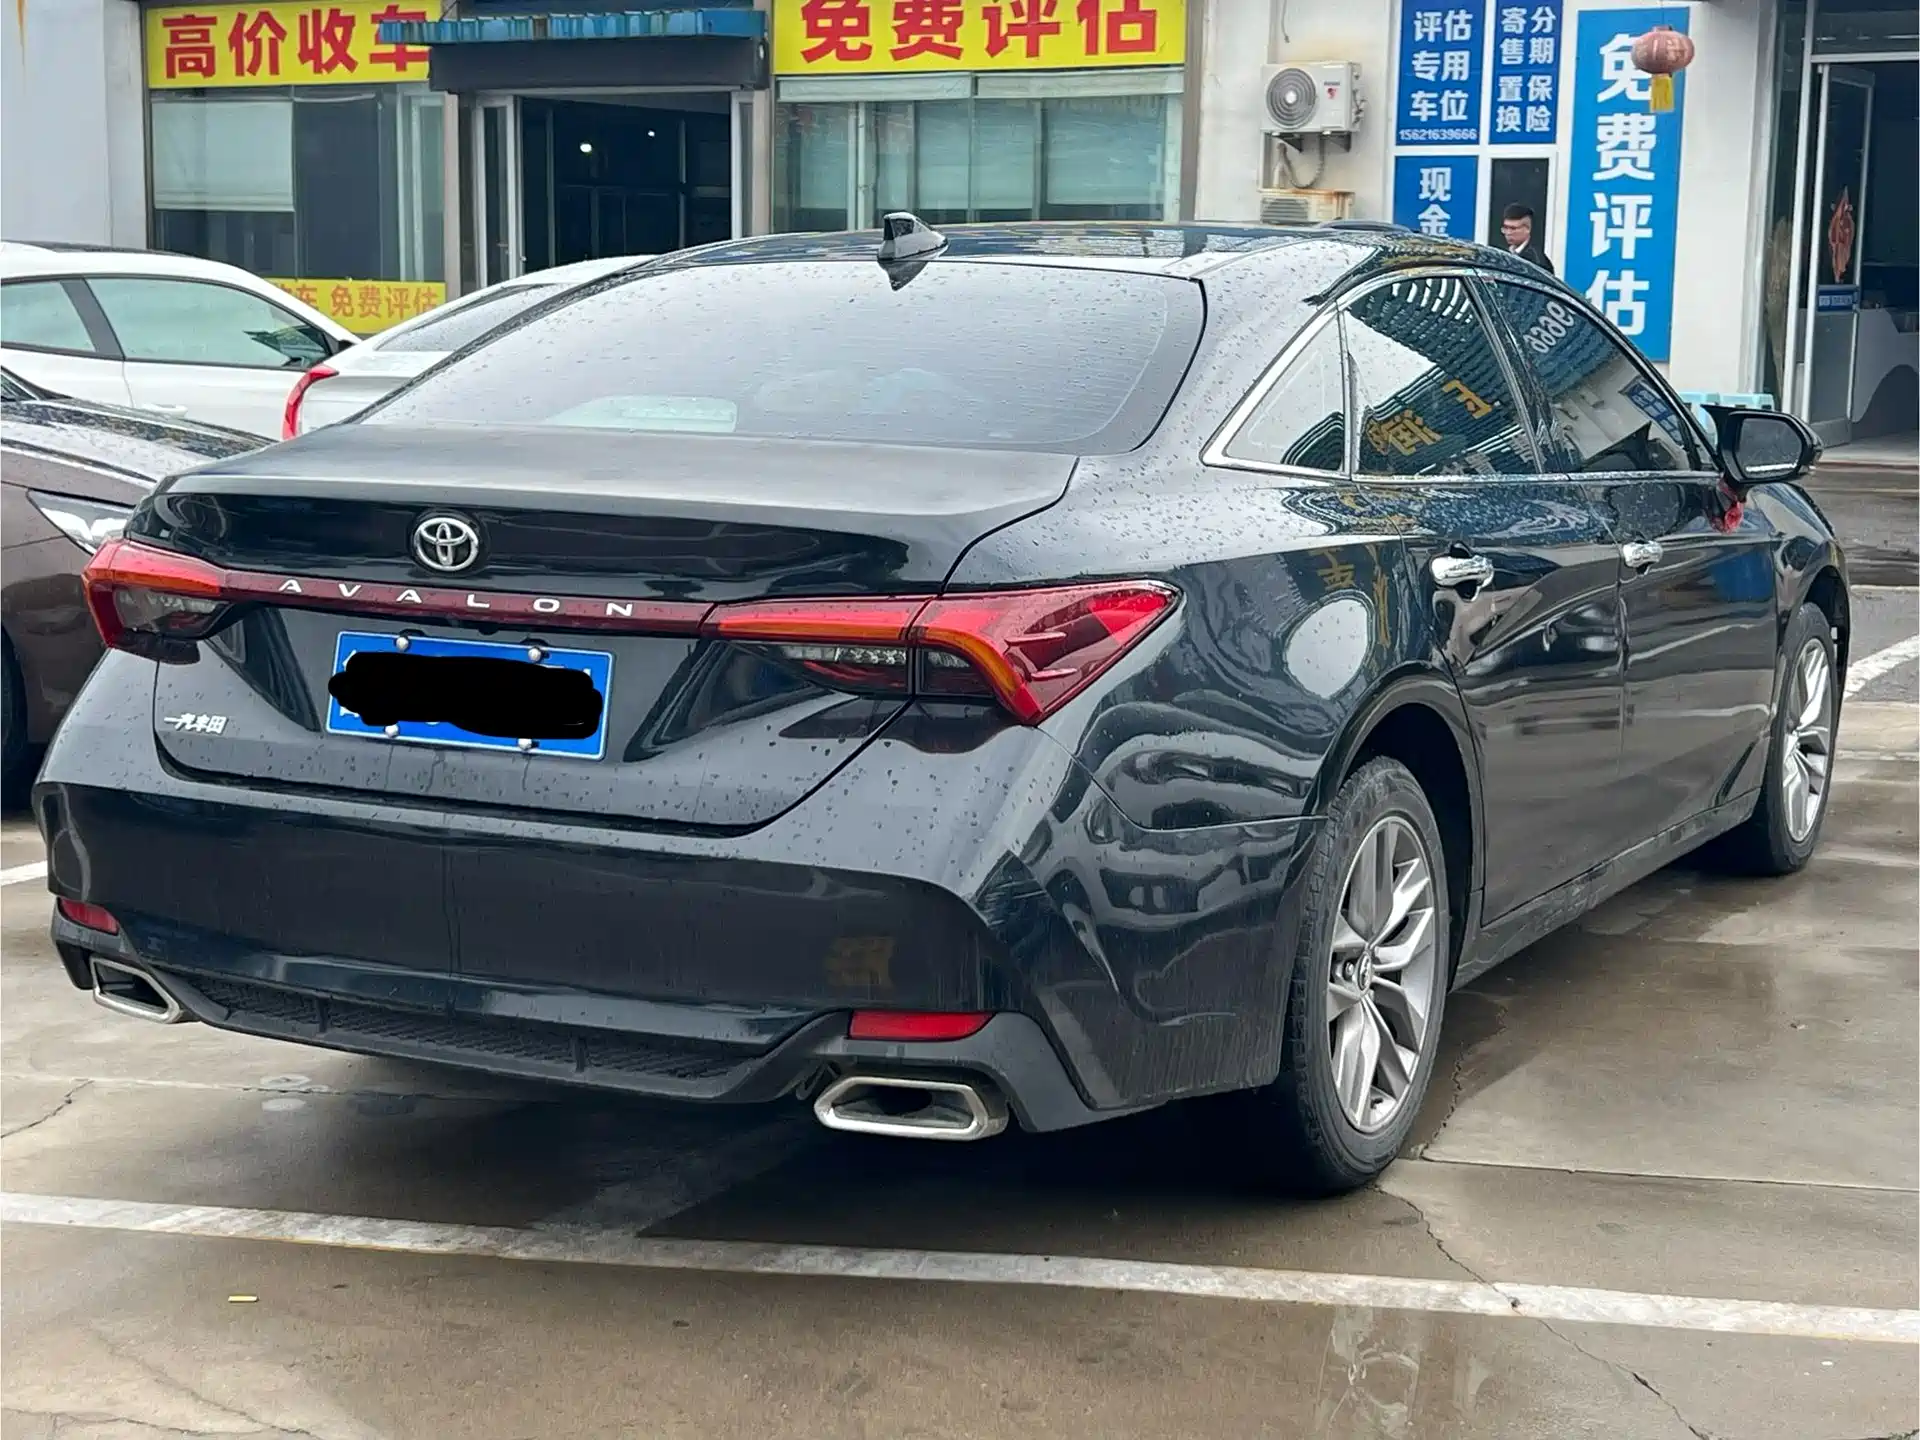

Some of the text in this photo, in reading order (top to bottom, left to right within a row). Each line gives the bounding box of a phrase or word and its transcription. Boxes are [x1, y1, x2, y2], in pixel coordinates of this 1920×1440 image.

[162, 4, 430, 79] 高价收车
[800, 0, 1157, 63] 免费评估
[1414, 9, 1473, 42] 评估
[1412, 50, 1470, 81] 专用
[1496, 7, 1527, 132] 寄售 置换
[1525, 6, 1556, 132] 分期 保险
[1410, 90, 1468, 121] 车位
[1399, 128, 1477, 141] 15621639666
[1418, 167, 1451, 238] 现金
[1585, 32, 1656, 335] 免费评估
[331, 284, 440, 318] 免费评估
[279, 578, 633, 617] AVALON
